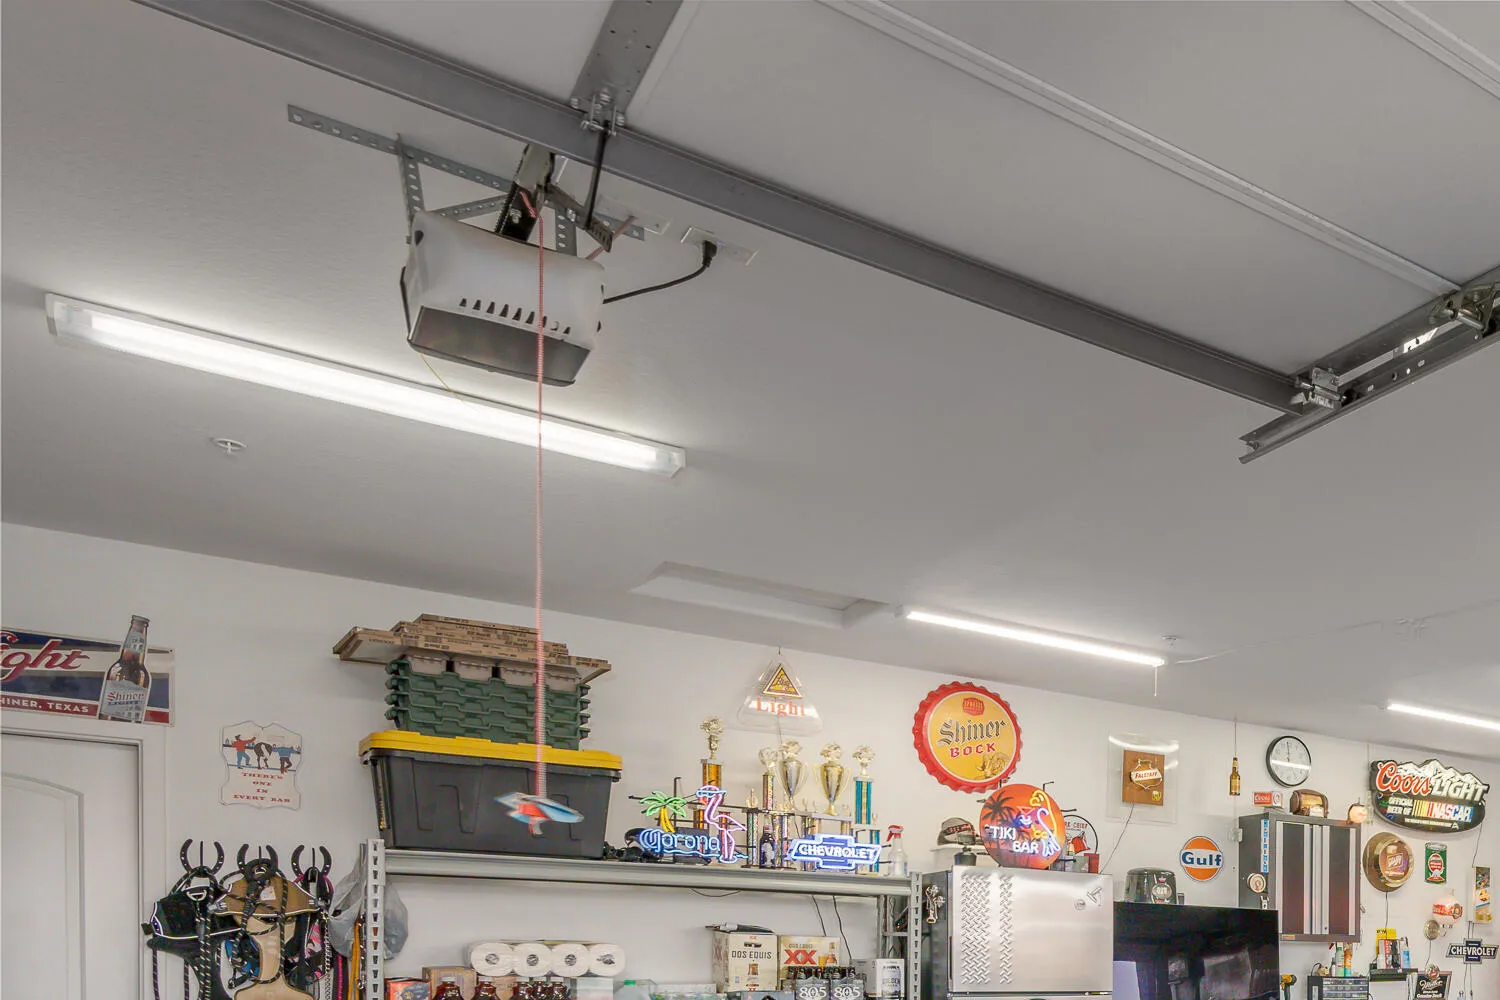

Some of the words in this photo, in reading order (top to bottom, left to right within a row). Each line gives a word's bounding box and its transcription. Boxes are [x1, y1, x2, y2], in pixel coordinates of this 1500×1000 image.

[48, 702, 89, 713] TEXAS
[756, 696, 806, 718] Light
[937, 718, 1007, 748] Shiner
[950, 742, 996, 758] BOCK
[1376, 761, 1431, 797] Coors
[1430, 774, 1488, 802] LIGHT
[1432, 801, 1473, 822] NASCAR
[638, 827, 721, 853] Corona
[986, 825, 1016, 840] TIKI
[797, 842, 877, 861] CHEVROLET
[1012, 841, 1040, 855] BAR
[1181, 851, 1222, 866] Gulf
[731, 950, 747, 959] DOS
[748, 951, 772, 960] EQUIS
[784, 949, 817, 965] XX
[1450, 946, 1495, 957] CHEVROLET
[1420, 978, 1443, 991] Miller
[799, 986, 828, 1000] 805
[834, 986, 861, 1000] 805
